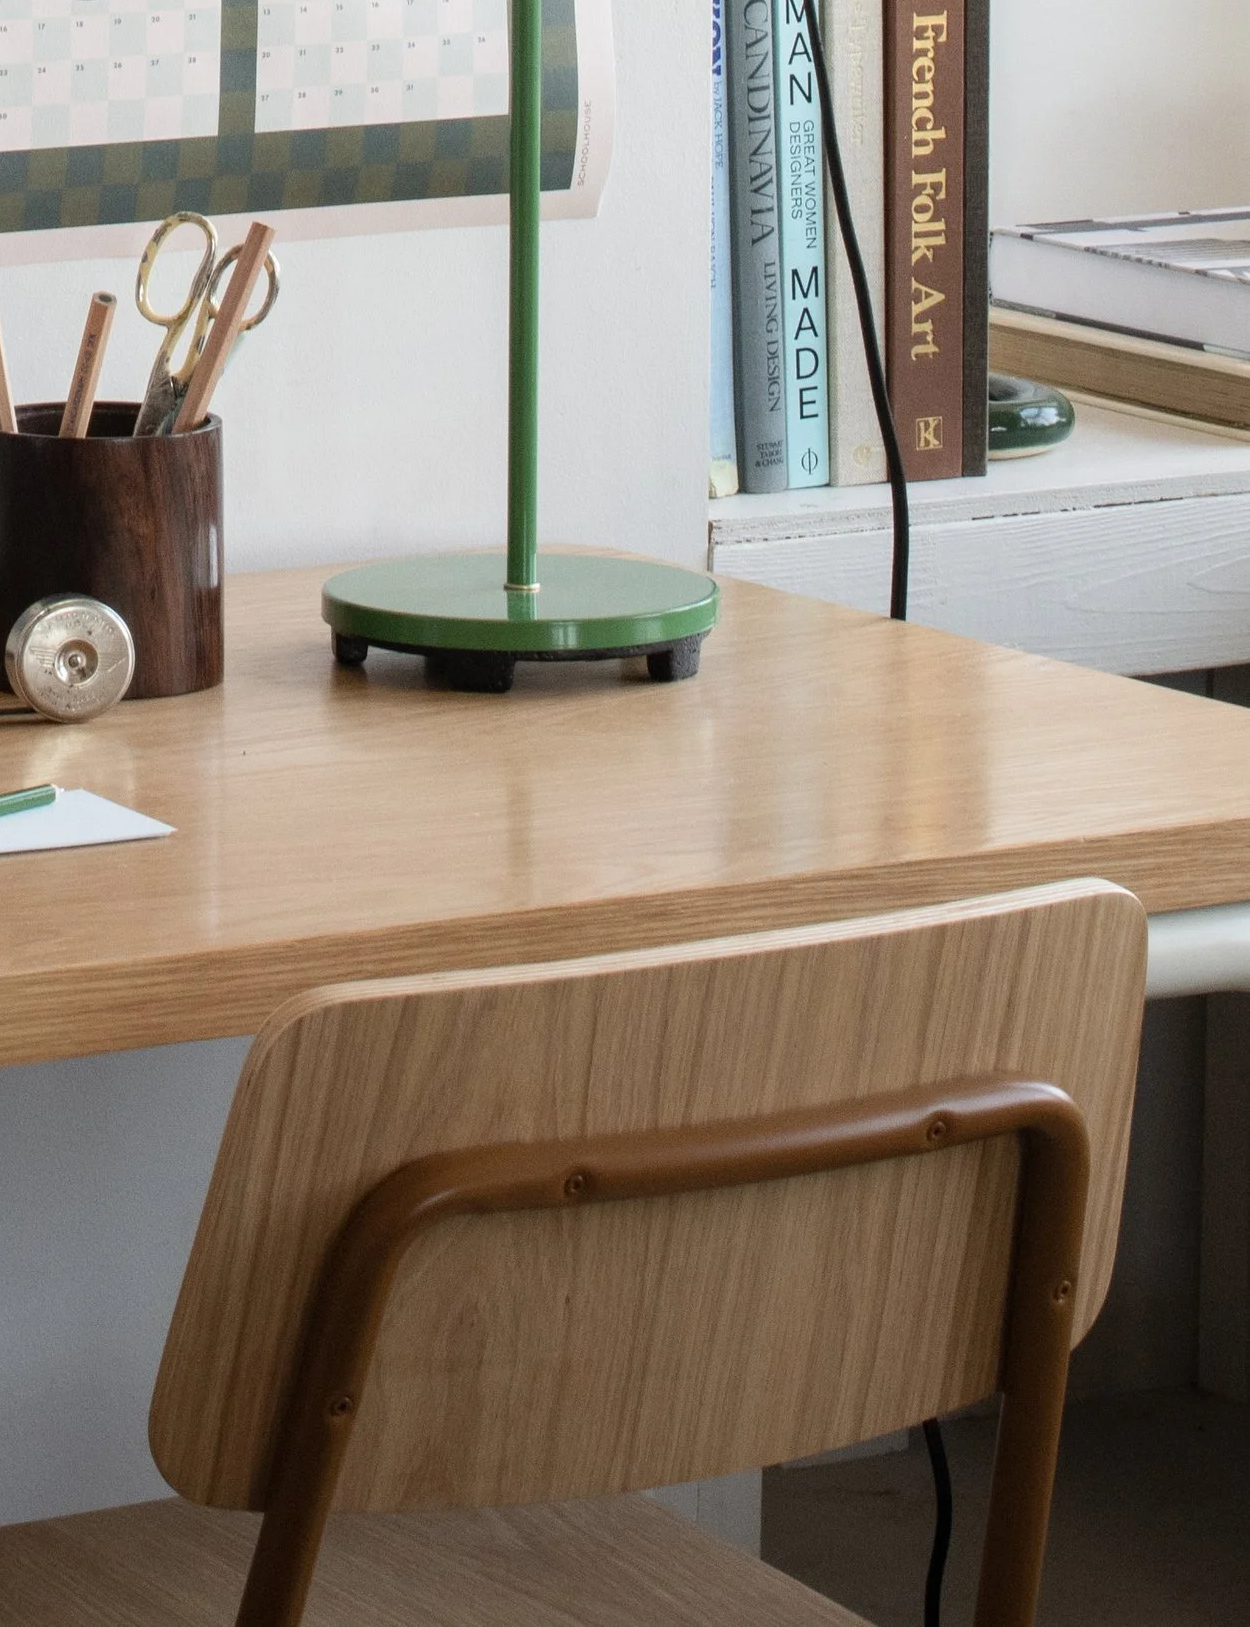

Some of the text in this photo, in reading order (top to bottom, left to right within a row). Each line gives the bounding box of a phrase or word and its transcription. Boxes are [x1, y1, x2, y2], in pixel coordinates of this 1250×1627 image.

[577, 99, 592, 186] SCHOOLHOUSE
[714, 133, 725, 170] HOPE
[789, 121, 803, 220] DESIGNERS
[803, 119, 818, 250] GREAT WOMEN
[910, 10, 948, 361] French Folk Art
[763, 261, 782, 413] LIVING DESIGN
[790, 266, 819, 420] MADE
